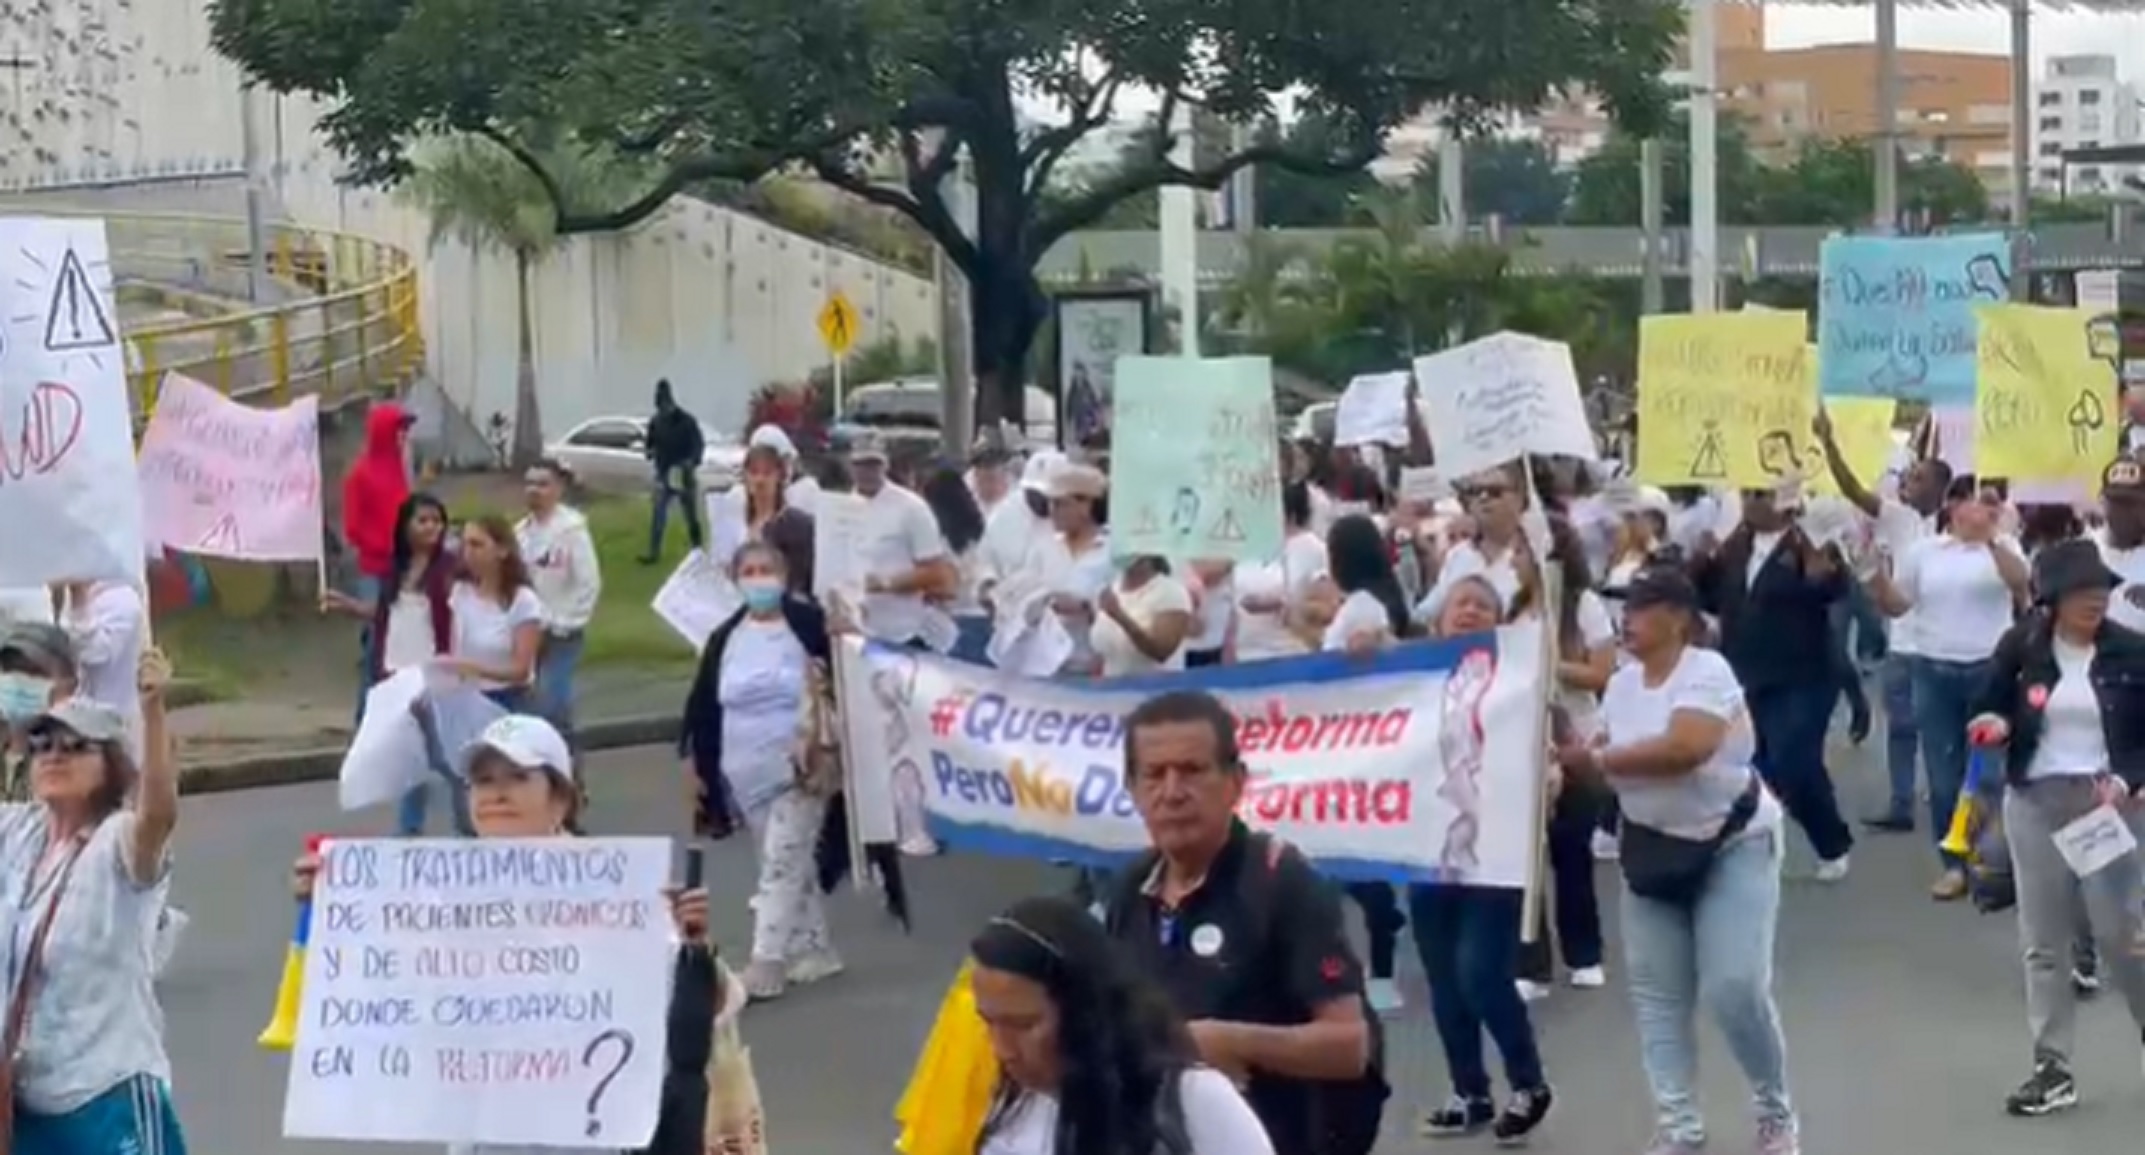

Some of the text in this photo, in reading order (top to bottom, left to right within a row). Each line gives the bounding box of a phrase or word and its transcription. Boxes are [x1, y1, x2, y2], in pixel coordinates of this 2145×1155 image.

[327, 844, 628, 889] LOS TRATAMIENTOS
[327, 902, 366, 932] DE
[383, 902, 516, 933] PACIENTES
[363, 945, 400, 979] DE
[499, 944, 580, 977] COSTO
[320, 997, 421, 1027] DONDE
[312, 1045, 354, 1077] EN
[379, 1045, 411, 1078] LA
